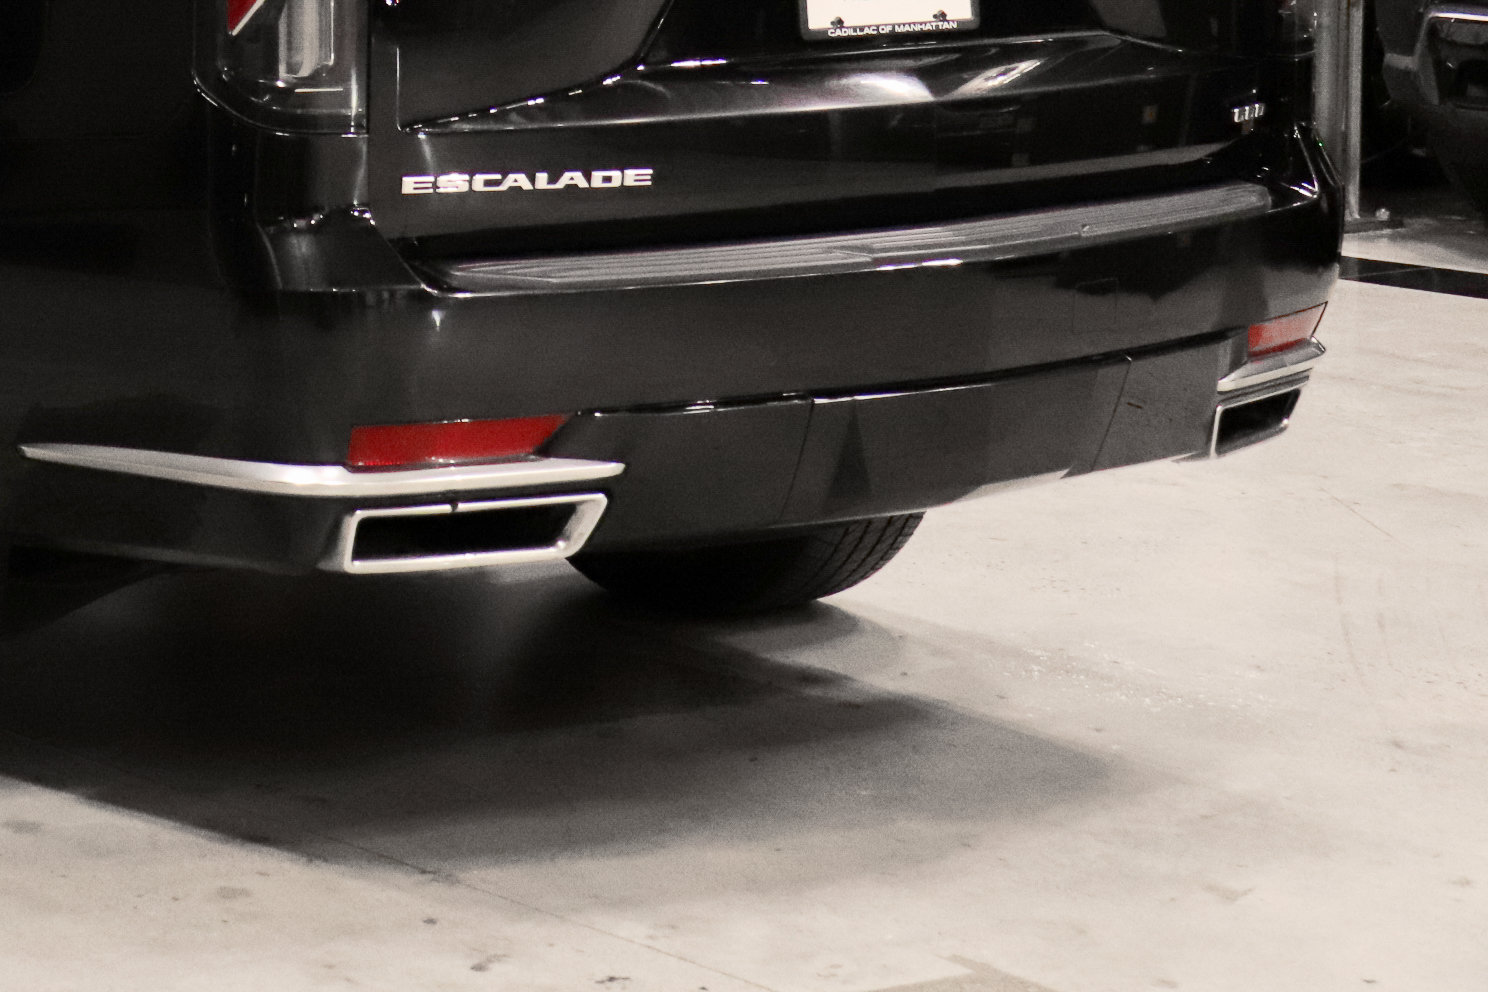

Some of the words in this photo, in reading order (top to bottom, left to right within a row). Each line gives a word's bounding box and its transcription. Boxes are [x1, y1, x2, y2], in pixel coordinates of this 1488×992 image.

[827, 25, 878, 37] CADILLAC
[878, 24, 893, 34] OF
[894, 21, 958, 33] MANHATTAN
[401, 167, 654, 195] ESCALADE
